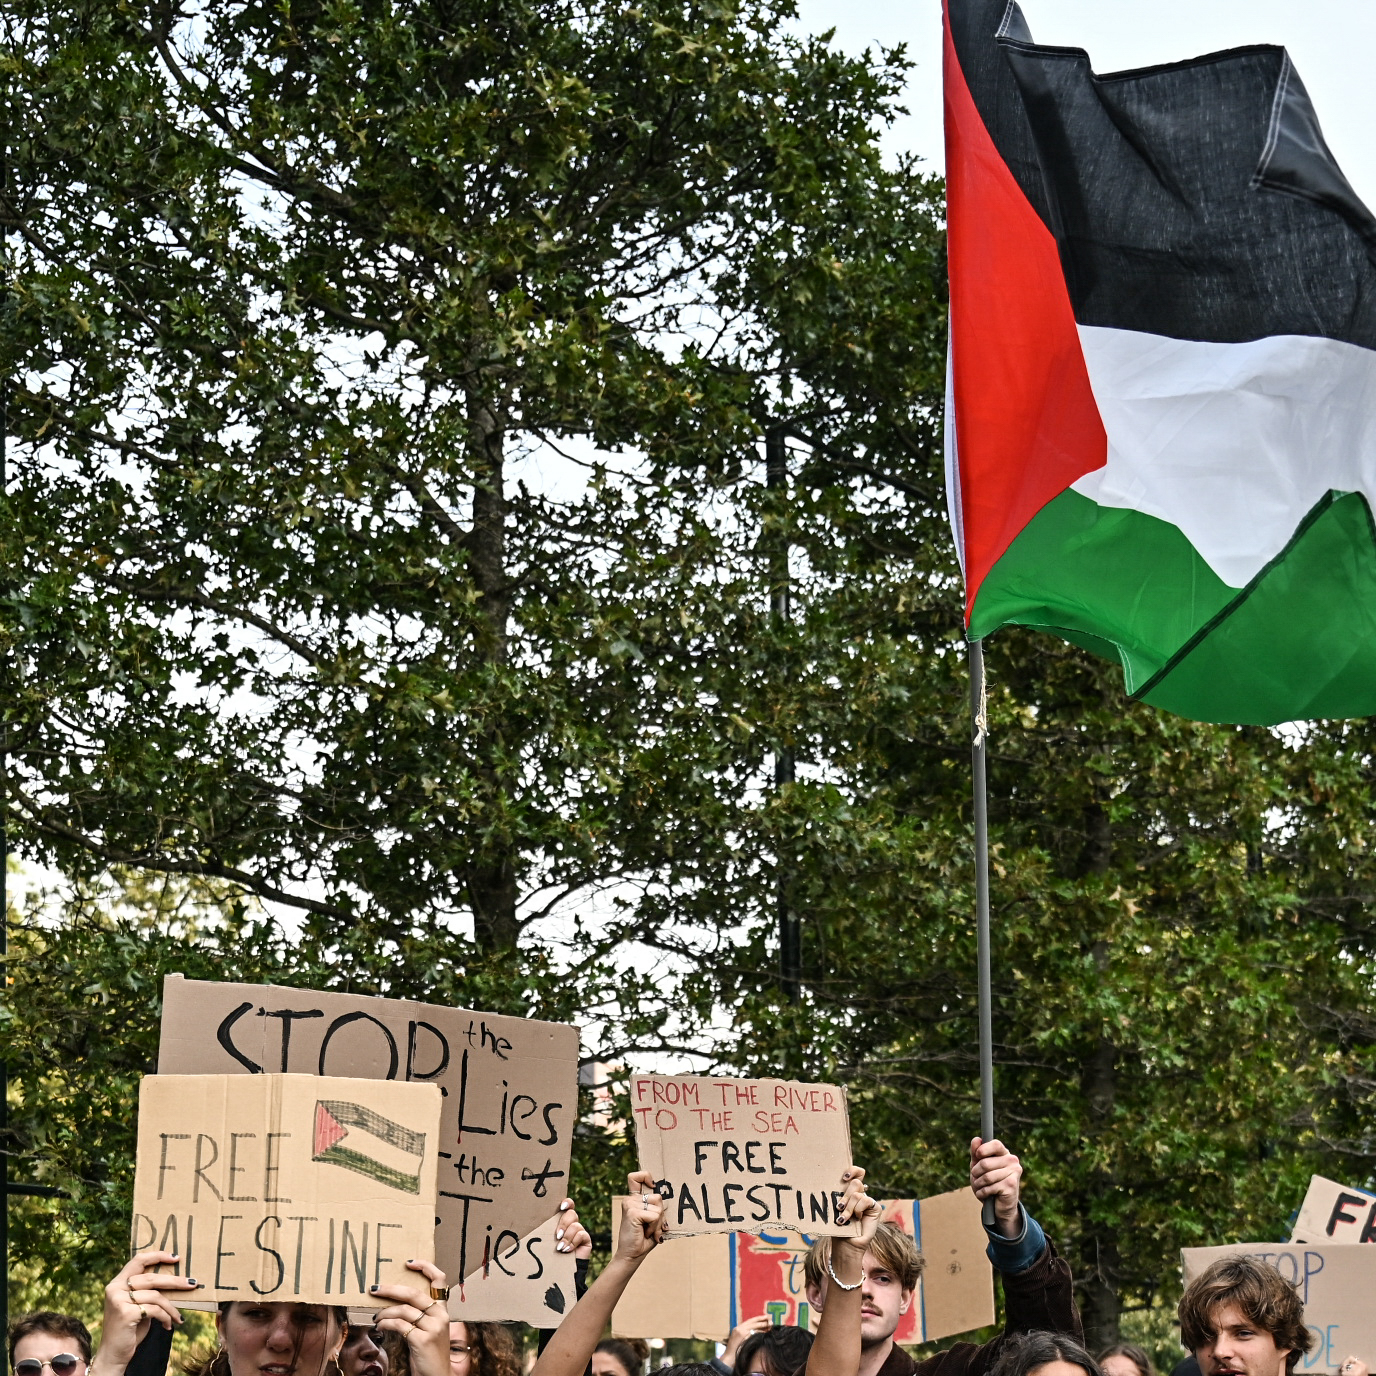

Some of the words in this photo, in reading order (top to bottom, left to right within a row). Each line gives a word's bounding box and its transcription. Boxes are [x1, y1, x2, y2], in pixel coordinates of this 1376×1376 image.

[216, 1001, 451, 1081] STOP
[462, 1020, 513, 1060] the
[458, 1048, 563, 1146] Lies
[635, 1107, 678, 1132] TO
[689, 1107, 735, 1133] THE
[751, 1110, 800, 1135] SEA
[636, 1079, 700, 1107] FROM
[713, 1082, 760, 1107] THE
[774, 1085, 837, 1113] RIVER
[157, 1132, 293, 1204] FREE
[453, 1153, 505, 1188] the
[694, 1140, 788, 1176] FREE
[131, 1213, 404, 1296] PALESTINE
[438, 1190, 544, 1285] Ties
